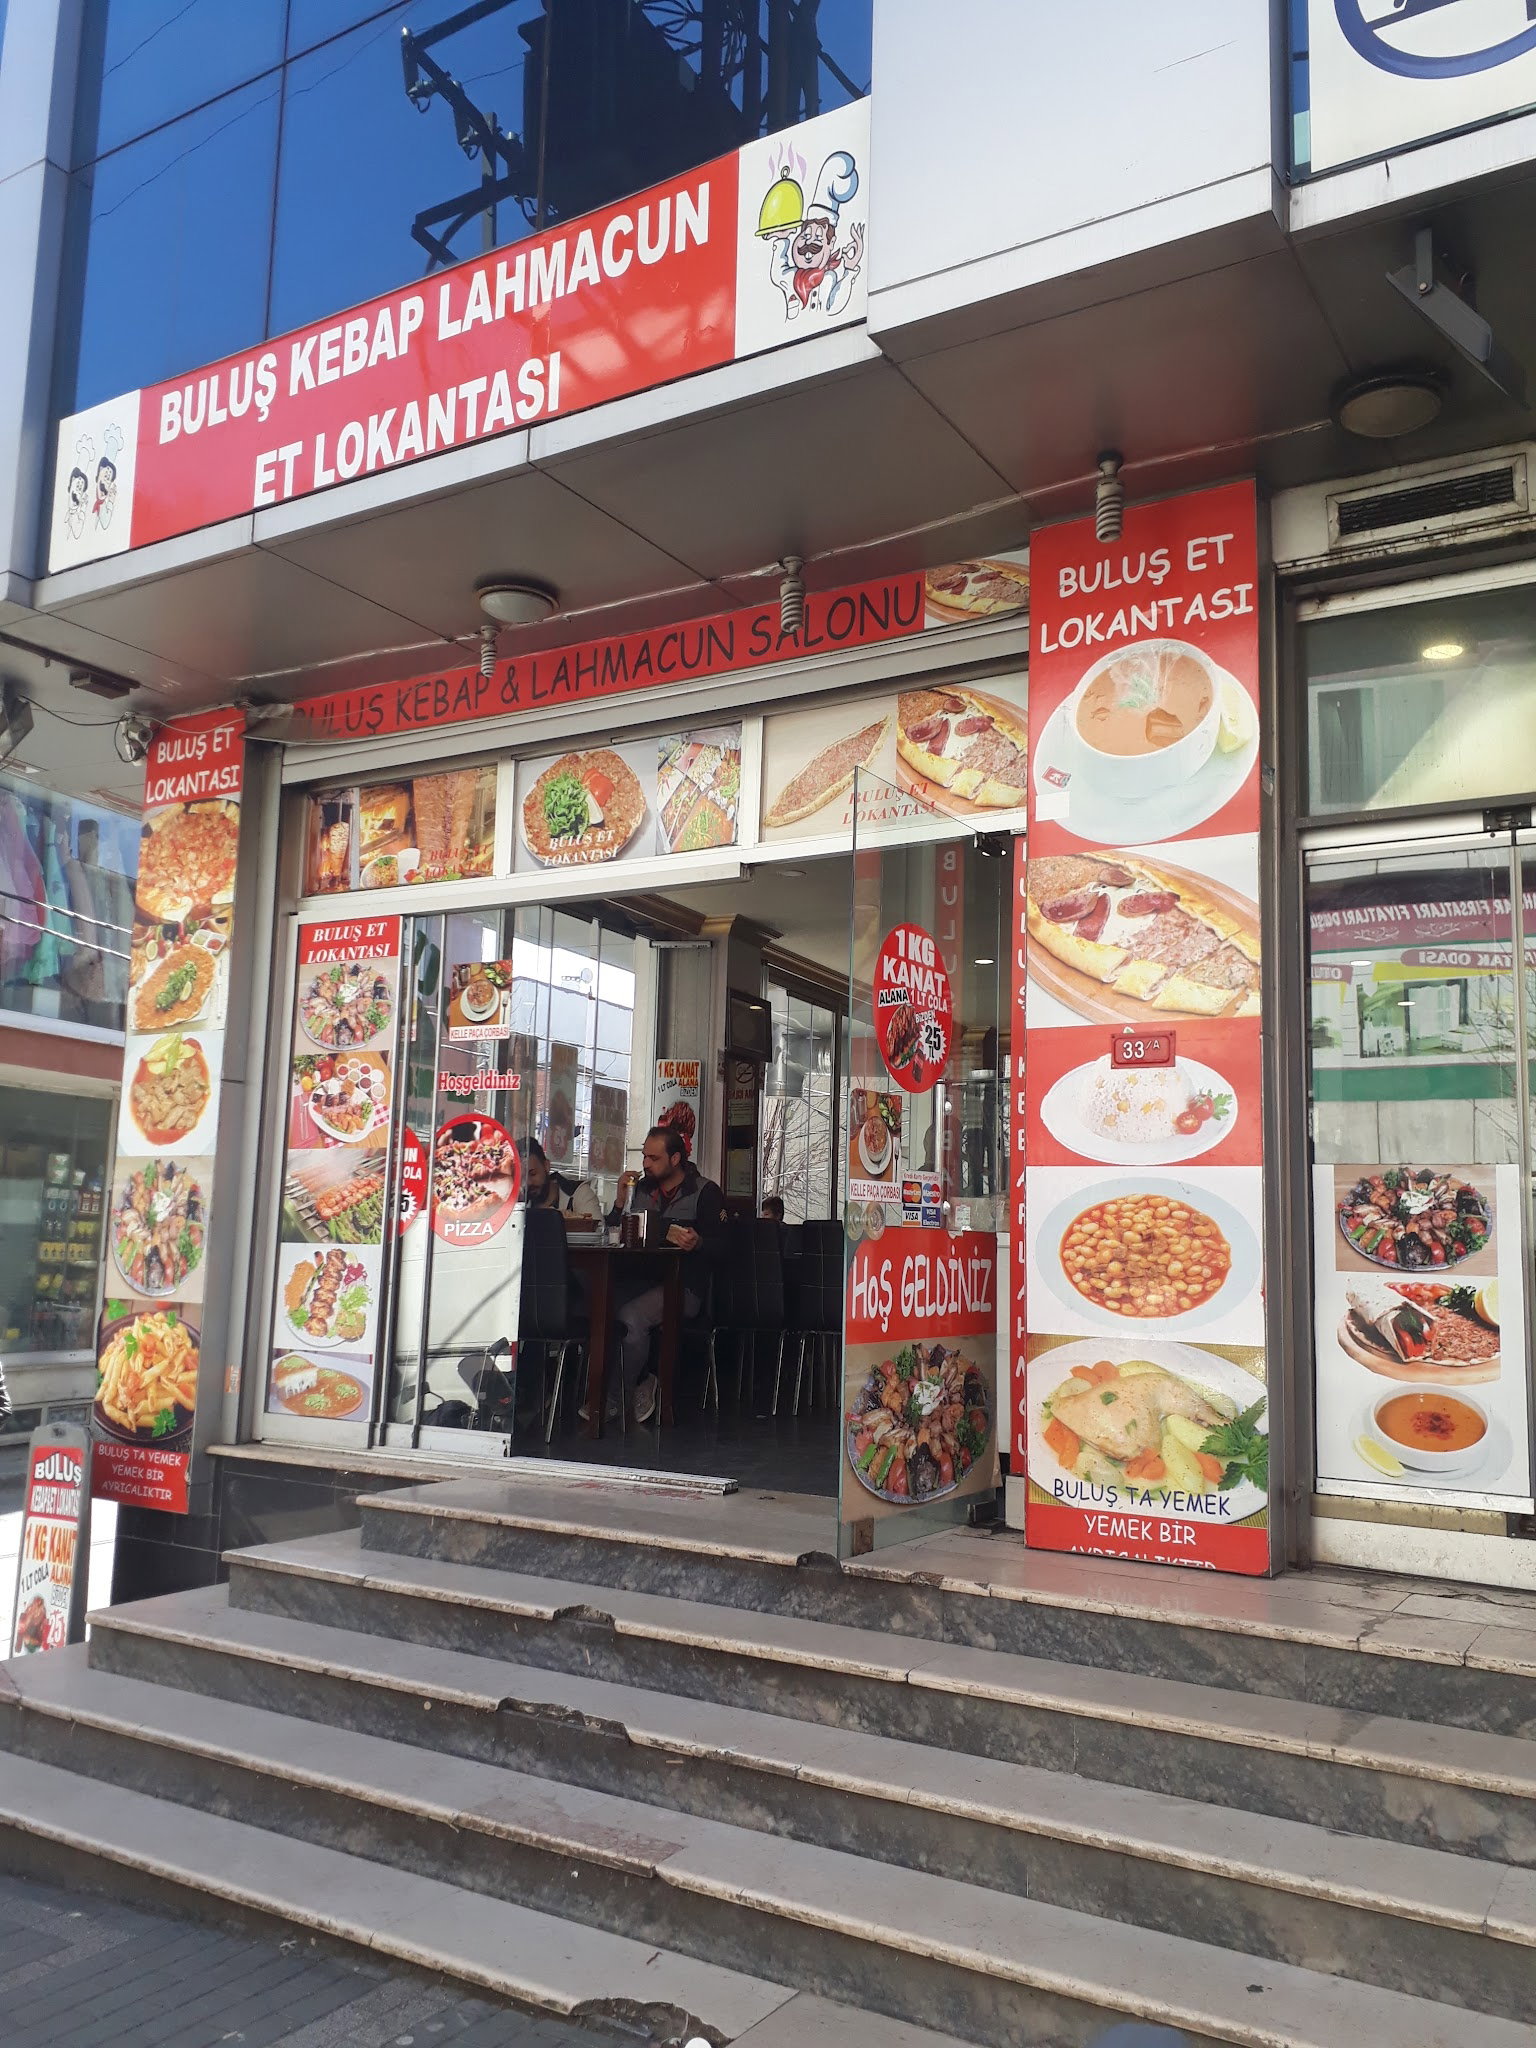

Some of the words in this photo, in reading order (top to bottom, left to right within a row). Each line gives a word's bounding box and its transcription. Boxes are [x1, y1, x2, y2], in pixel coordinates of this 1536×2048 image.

[158, 359, 277, 445] BULUŞ
[288, 295, 424, 396] KEBAP
[437, 183, 711, 340] LAHMACUN
[252, 441, 302, 507] ET
[313, 352, 562, 487] LOKANTASI
[1059, 548, 1171, 598] BULUŞ
[1187, 533, 1234, 571] ET
[1040, 583, 1253, 653] LOKANTASI
[394, 677, 490, 726] KEBAP
[500, 664, 520, 705] &
[531, 621, 734, 700] LAHMACUN
[157, 734, 207, 764] BULUŞ
[213, 727, 235, 753] ET
[146, 764, 240, 803] LOKANTASI
[312, 924, 362, 943] BULUŞ
[366, 922, 387, 938] ET
[306, 943, 391, 964] LOKANTASI
[895, 929, 905, 957] 1
[908, 932, 936, 968] KG
[883, 954, 946, 998] KANAT
[879, 989, 909, 1005] ALANA
[928, 994, 948, 1014] COLA
[925, 1025, 941, 1051] 25
[438, 1069, 520, 1095] Hoşgeldiniz
[676, 1061, 700, 1078] KANAT
[851, 1182, 866, 1197] KELLE
[444, 1220, 494, 1237] PİZZA
[905, 1211, 919, 1221] VISA
[901, 1244, 992, 1318] GELDİNİZ
[34, 1453, 82, 1487] BULUŞ
[98, 1445, 129, 1461] BULUŞ
[133, 1449, 145, 1461] TA
[148, 1452, 182, 1466] YEMEK
[112, 1464, 144, 1479] YEMEK
[1054, 1478, 1118, 1507] BULUŞ
[1125, 1486, 1152, 1508] TA
[1159, 1490, 1231, 1516] YEMEK
[1084, 1514, 1153, 1541] YEMEK
[1159, 1520, 1197, 1545] BİR
